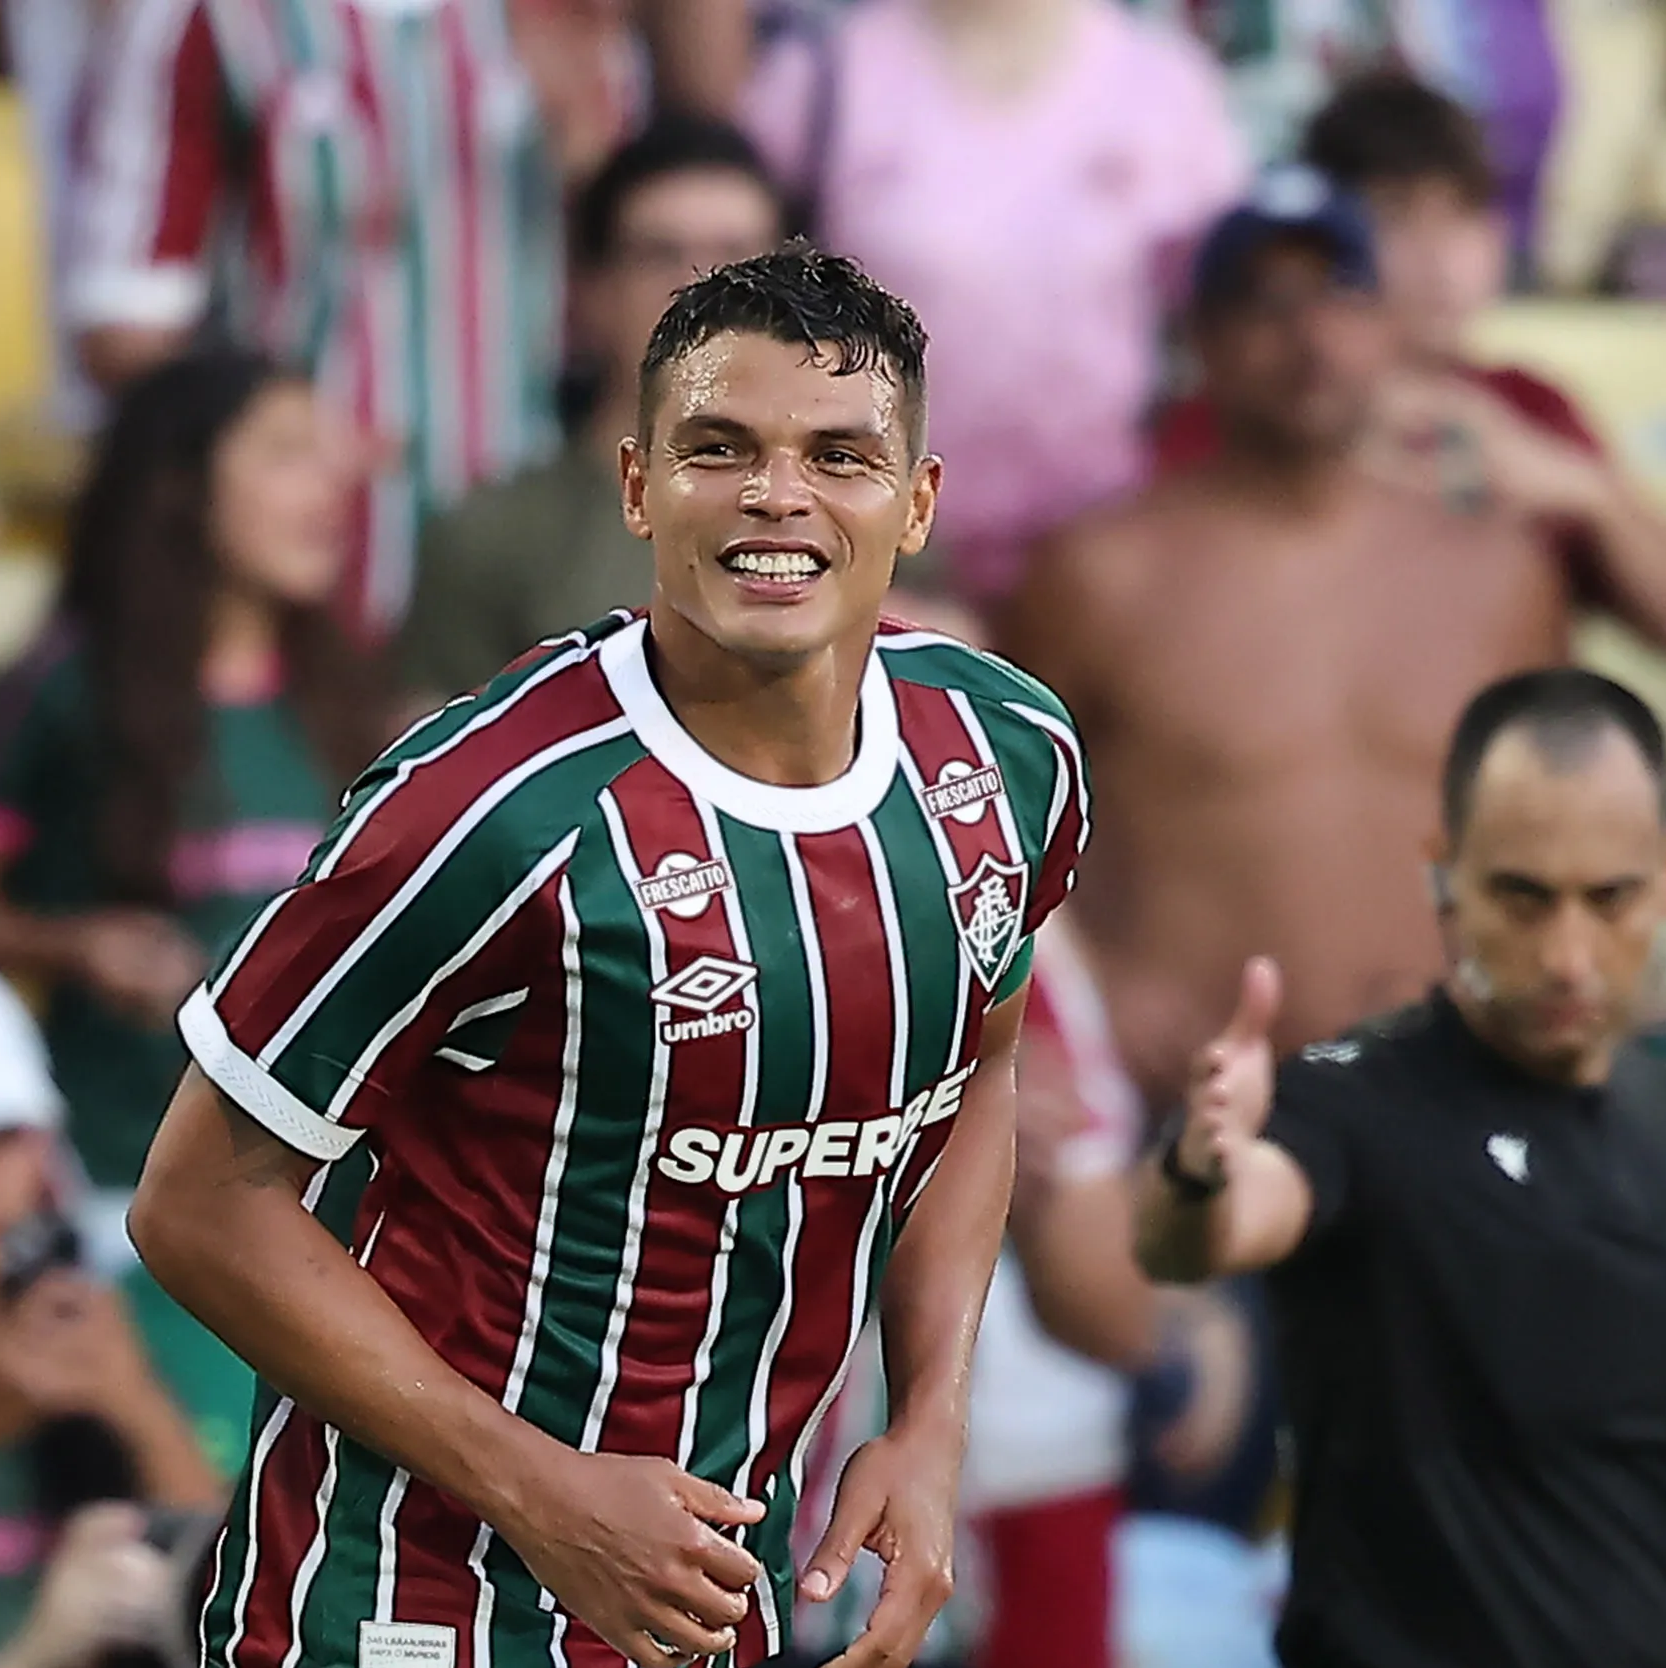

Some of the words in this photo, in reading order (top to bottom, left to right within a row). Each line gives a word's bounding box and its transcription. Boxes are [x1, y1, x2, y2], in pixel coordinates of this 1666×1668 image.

[925, 770, 999, 814] FRESCATTO
[640, 864, 726, 906] FRESCATTO
[662, 1007, 753, 1043] umbro
[658, 1058, 978, 1193] SUPERBE
